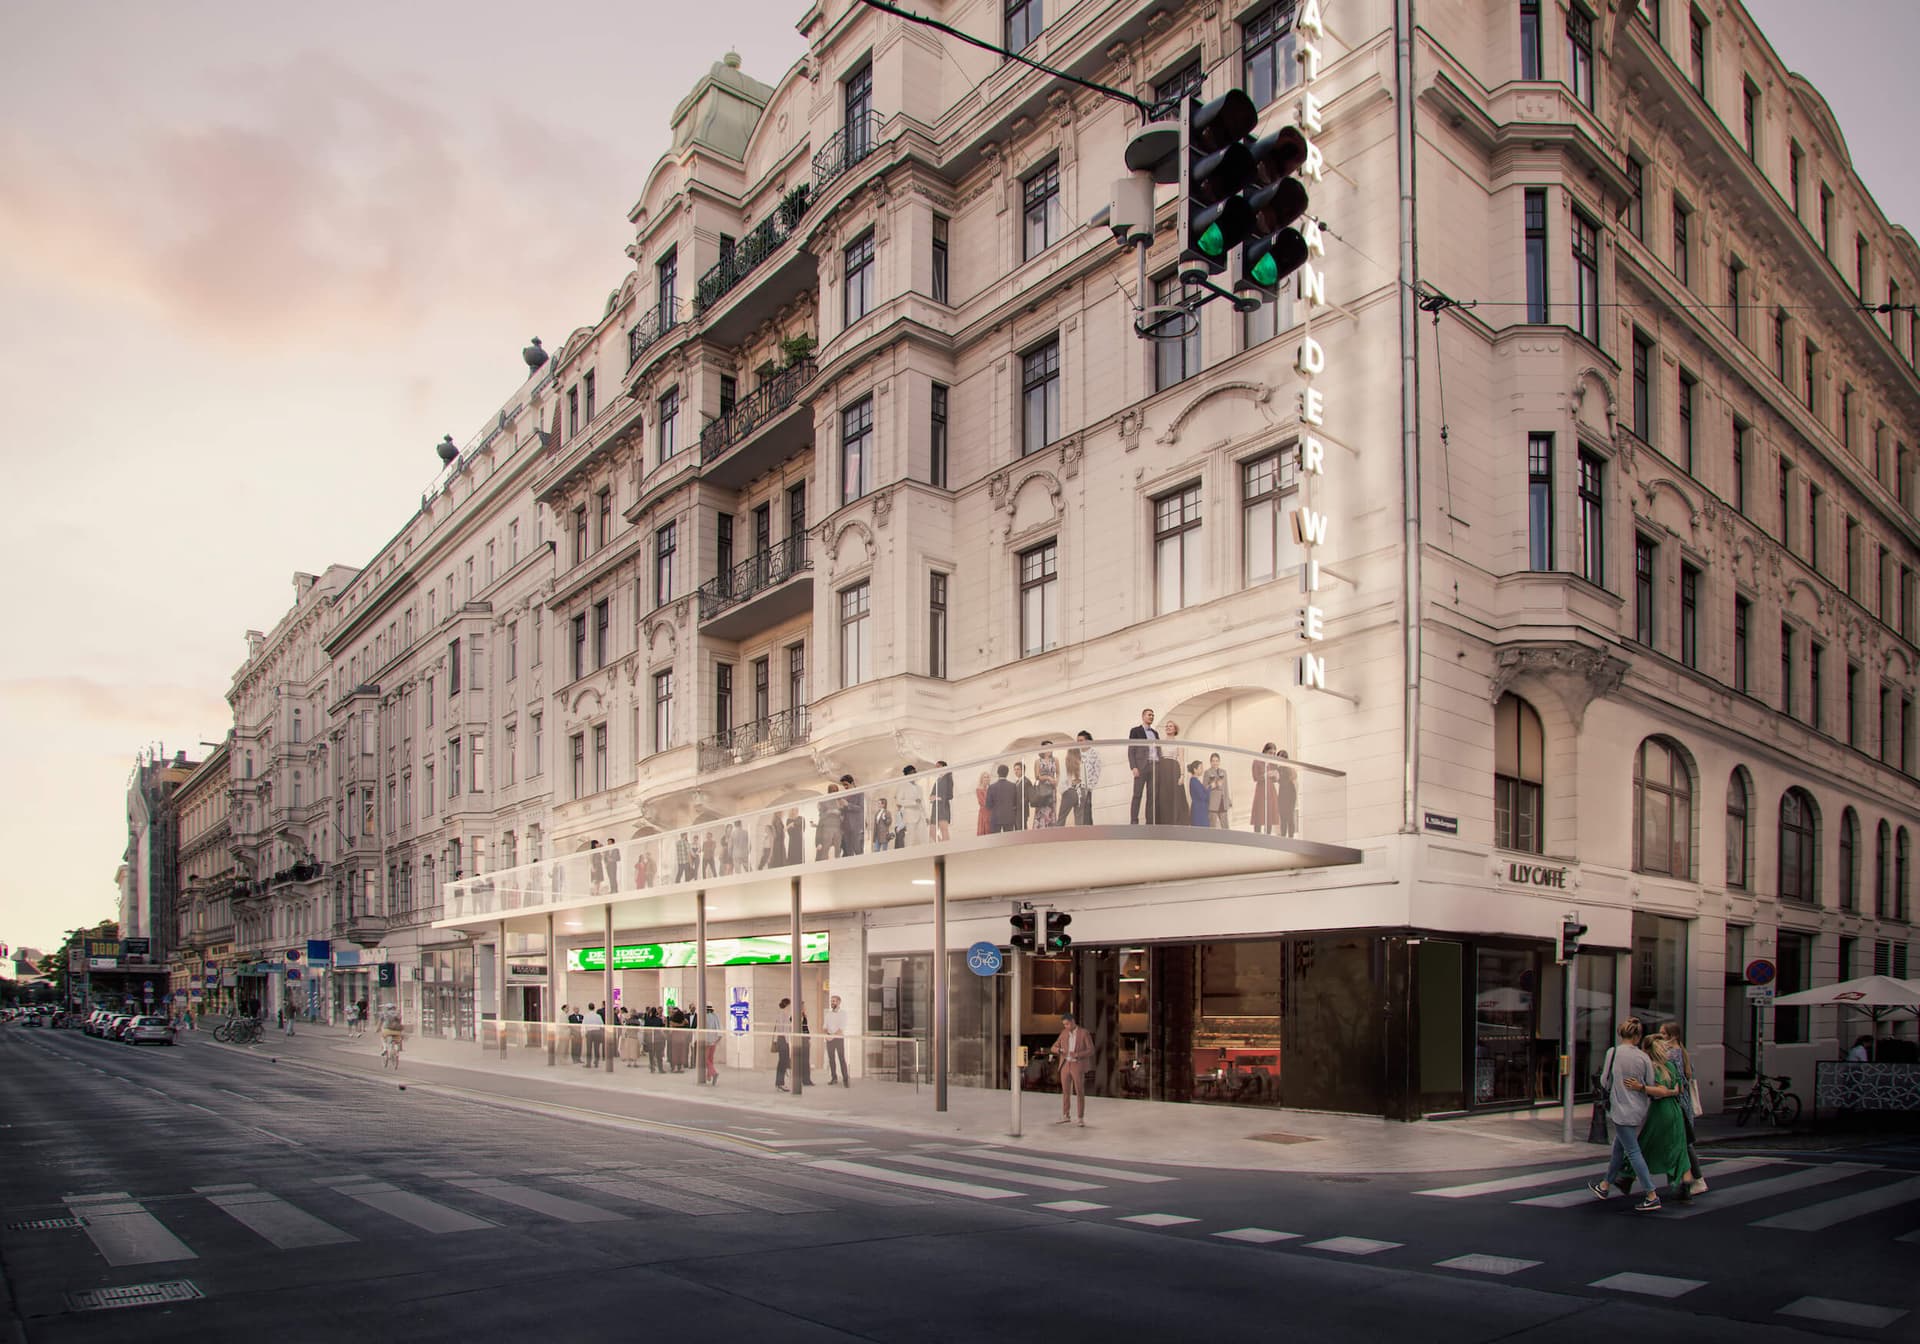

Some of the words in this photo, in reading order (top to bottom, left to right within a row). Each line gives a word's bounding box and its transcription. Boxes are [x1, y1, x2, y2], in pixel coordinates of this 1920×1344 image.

[1303, 220, 1325, 306] AN
[1302, 336, 1325, 475] DER
[1302, 506, 1328, 689] WIEN
[1532, 866, 1567, 889] CAFFÉ
